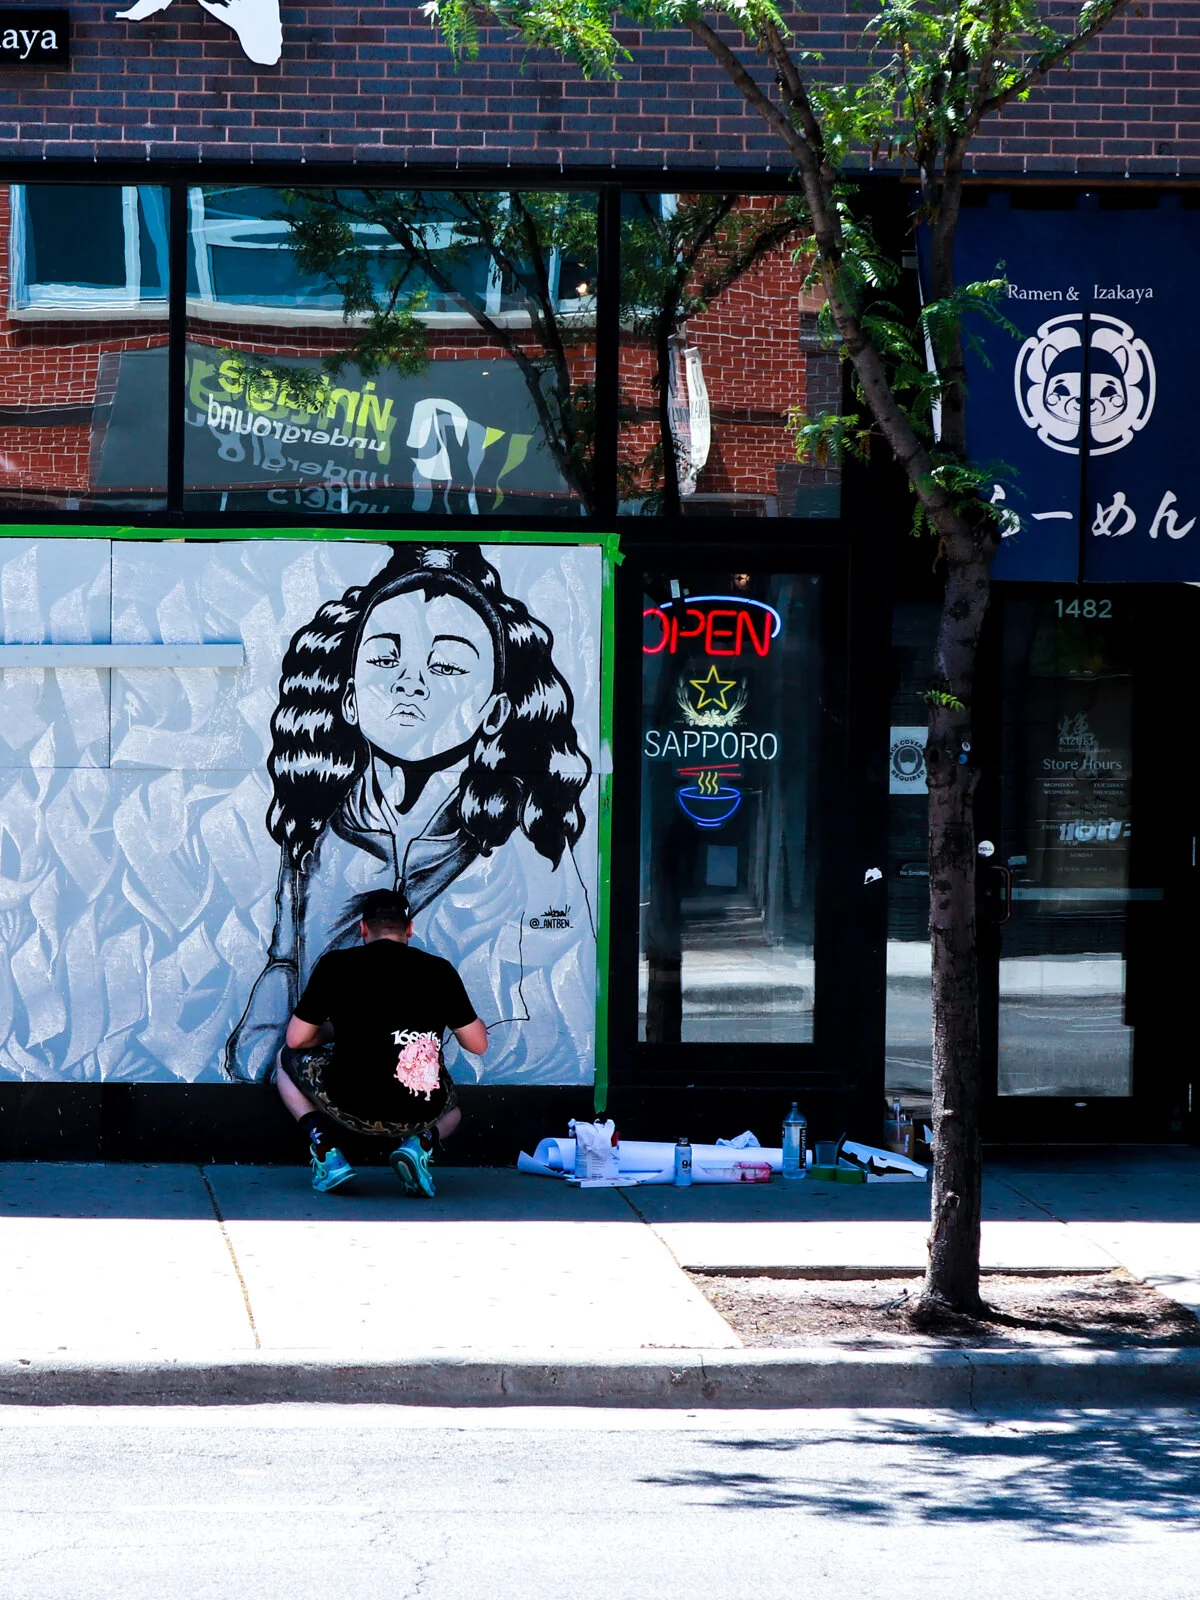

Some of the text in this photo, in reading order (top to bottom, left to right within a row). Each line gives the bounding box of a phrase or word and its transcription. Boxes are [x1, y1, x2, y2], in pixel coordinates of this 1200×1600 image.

[1007, 284, 1154, 304] Ramen & Izakaya
[1055, 599, 1113, 618] 1482
[642, 608, 772, 656] OPEN
[644, 730, 778, 760] SAPPORO
[1042, 758, 1122, 770] Store Hours
[891, 769, 925, 782] REQUIRED
[529, 918, 574, 929] @_ANTBEN_
